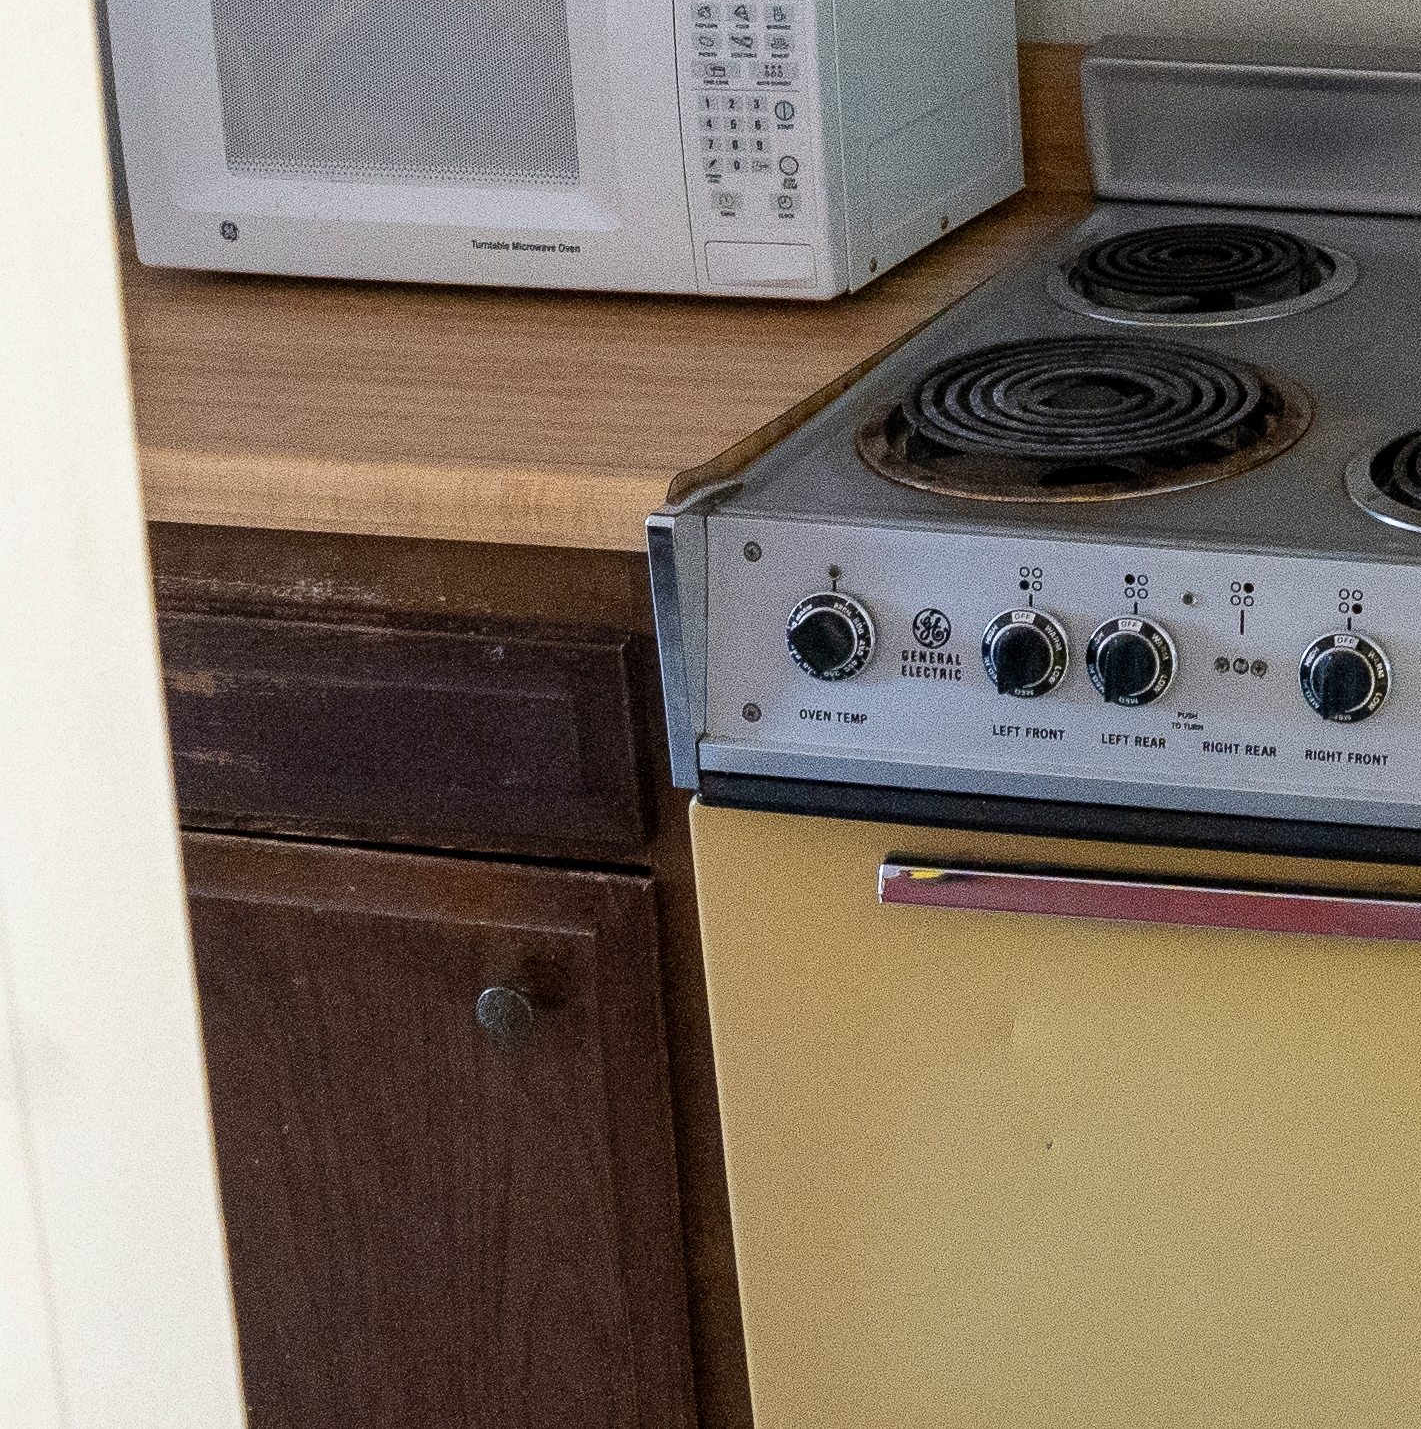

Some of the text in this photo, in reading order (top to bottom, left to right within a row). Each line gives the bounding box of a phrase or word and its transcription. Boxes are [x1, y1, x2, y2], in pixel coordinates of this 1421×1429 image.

[729, 98, 735, 110] 2
[754, 98, 760, 110] 3
[706, 118, 761, 131] 4 5 6
[708, 138, 714, 150] 7
[757, 139, 763, 152] 9
[733, 159, 740, 171] 0
[471, 239, 581, 253] Turntable Microwave Oven
[1014, 612, 1031, 621] OFF
[1121, 621, 1138, 629] OFF
[1044, 624, 1063, 652] WARM
[1336, 637, 1354, 646] OFF
[901, 650, 962, 666] GENERAL
[901, 665, 962, 681] ELECTRIC
[799, 709, 868, 725] OVEN TEMP
[1177, 711, 1198, 720] PUSH
[992, 724, 1066, 741] LEFT FRONT
[1183, 722, 1204, 731] TURN
[1101, 733, 1167, 749] LEFT REAR
[1202, 741, 1277, 758] RIGHT REAR
[1304, 749, 1389, 766] RIGHT FRONT
